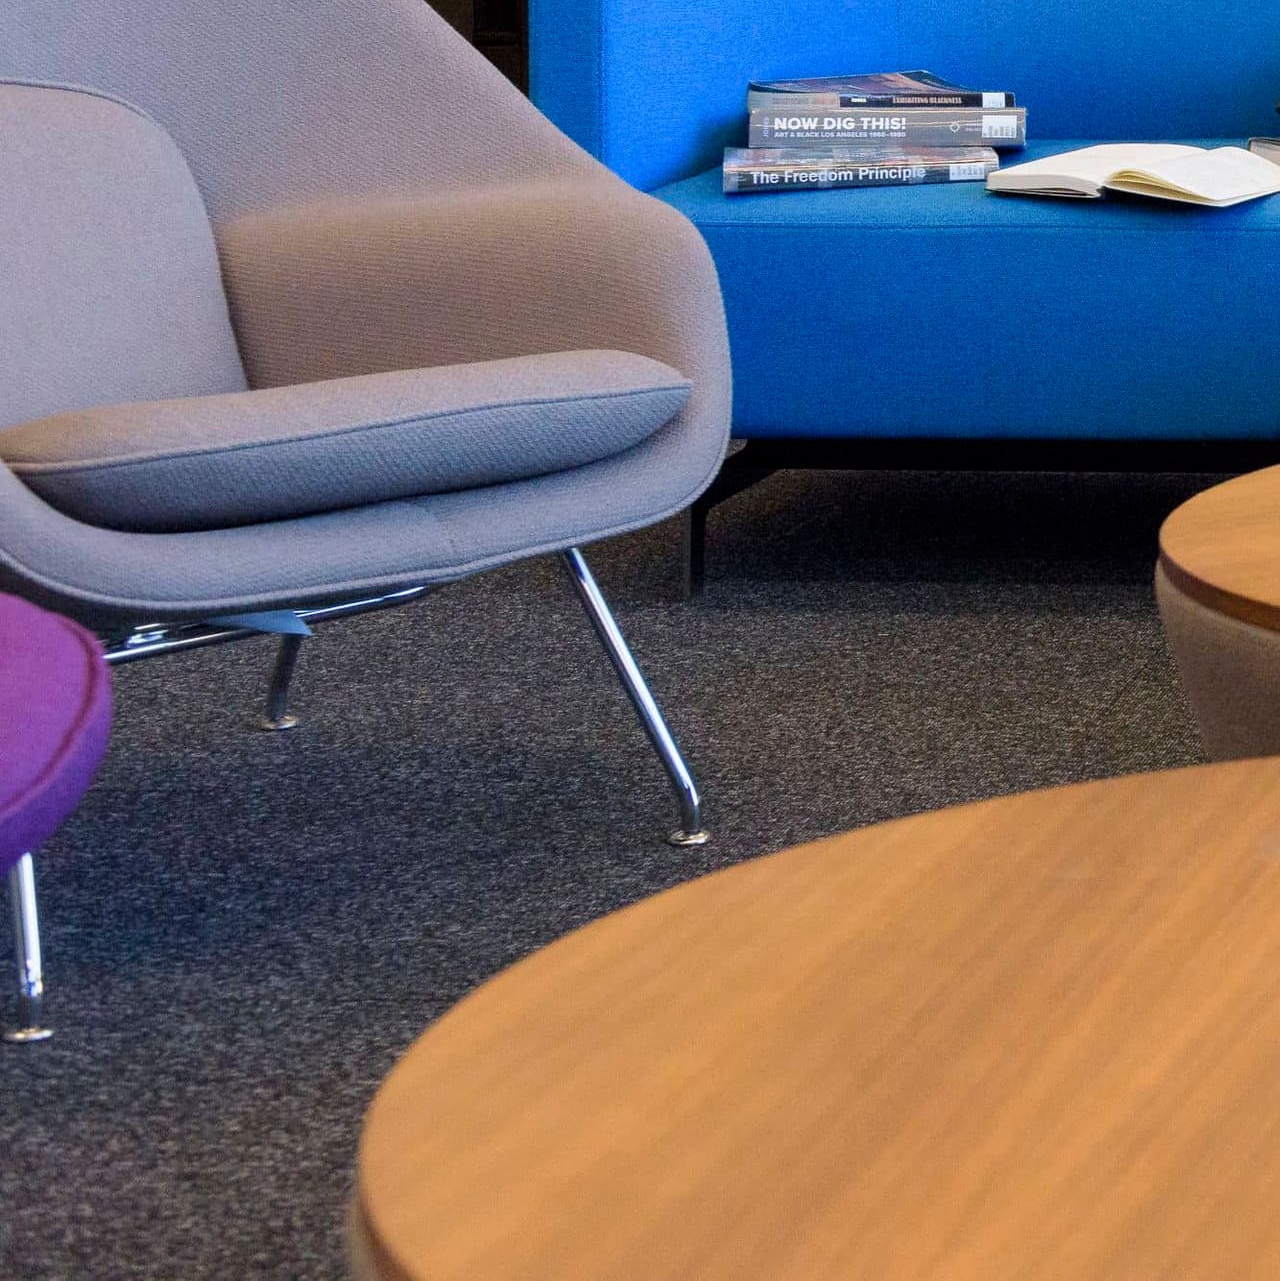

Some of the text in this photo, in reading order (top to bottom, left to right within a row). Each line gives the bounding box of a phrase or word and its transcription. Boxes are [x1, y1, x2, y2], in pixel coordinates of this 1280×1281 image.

[774, 118, 906, 130] NOW DIG THIS!
[750, 166, 926, 184] The Freedom Principle
